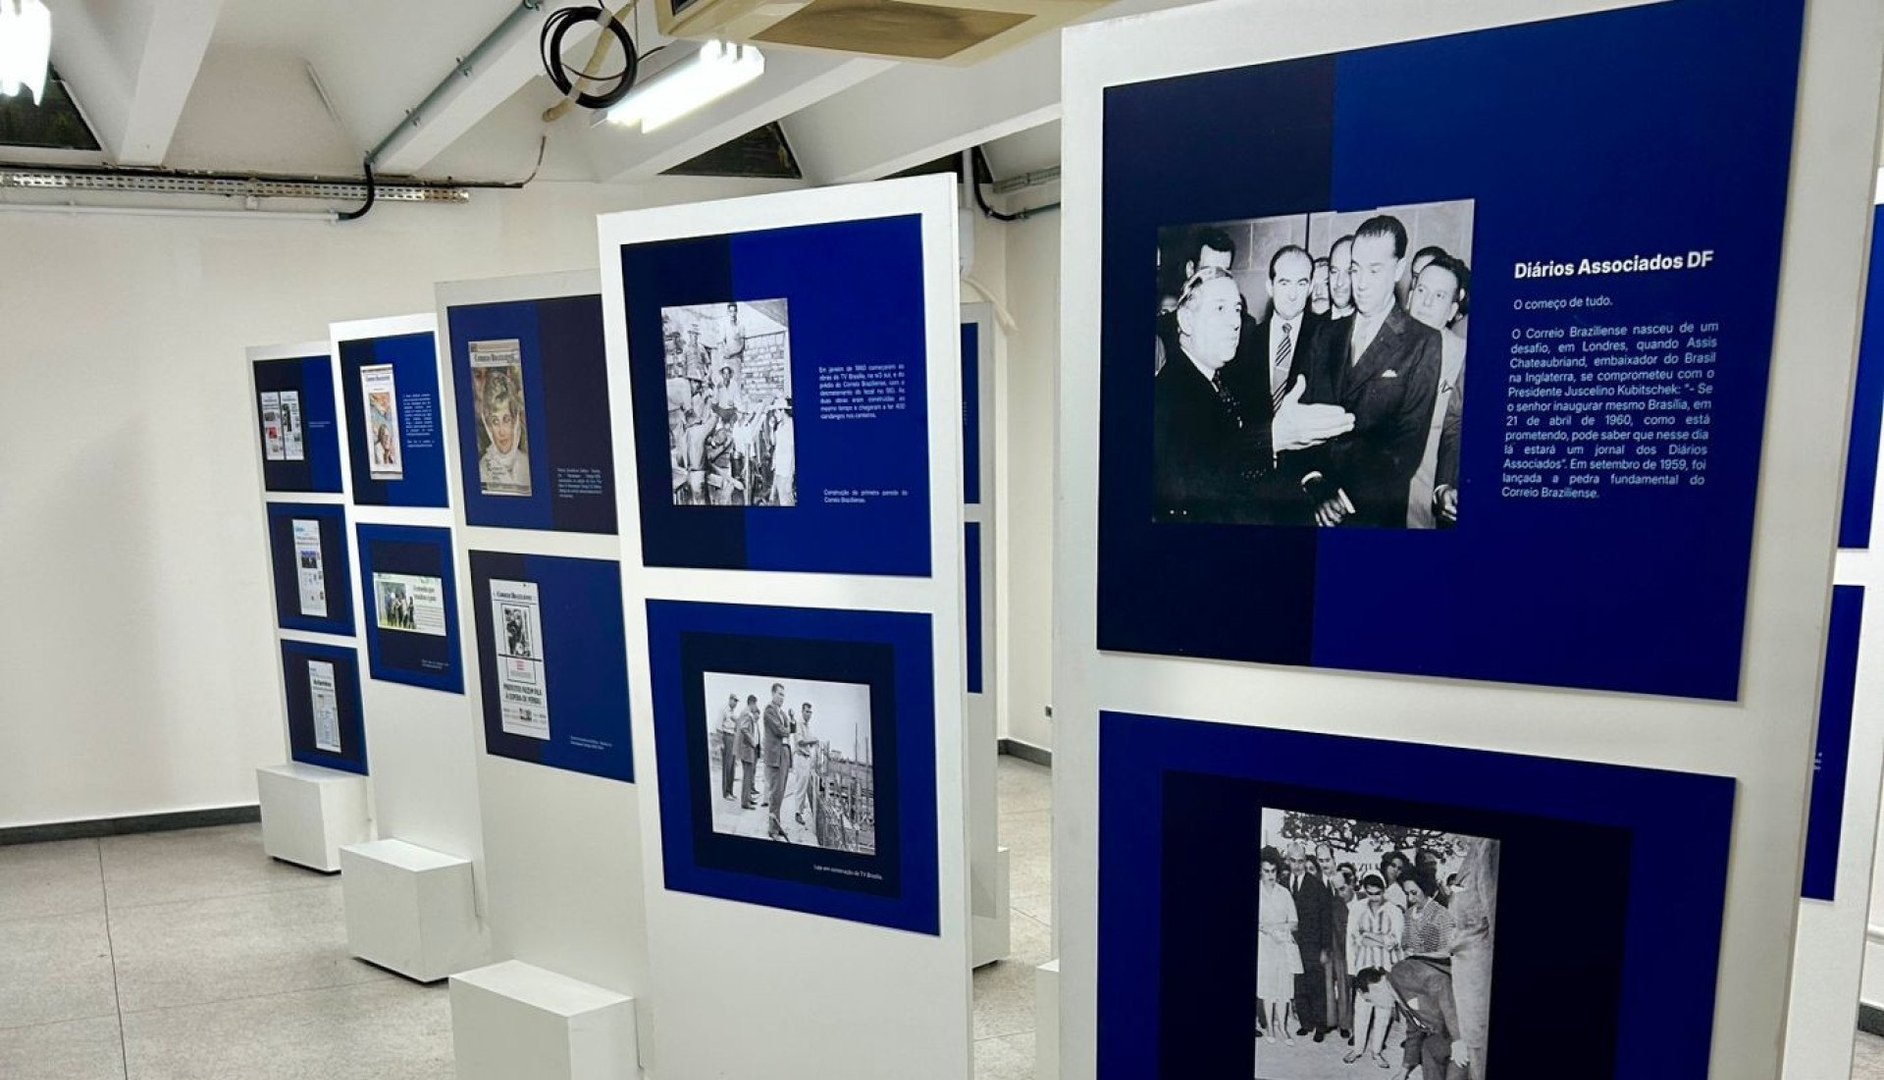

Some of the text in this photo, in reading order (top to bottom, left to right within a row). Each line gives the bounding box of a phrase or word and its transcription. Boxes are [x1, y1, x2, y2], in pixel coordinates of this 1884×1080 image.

[1514, 250, 1713, 278] Diários Associados DF
[1513, 296, 1612, 309] O começo de tudo.
[1511, 322, 1718, 339] O Correio Braziliense nasceu de um
[1510, 337, 1716, 353] desafio, em Londres, quando Assis
[1509, 352, 1715, 368] Chateaubriand, embaixador do Brasil
[1508, 369, 1714, 384] na Inglaterra, se comprometeu com o
[1508, 386, 1562, 397] Presidente
[1564, 385, 1614, 396] Juscelino
[1617, 383, 1680, 395] Kubitschek:
[1698, 383, 1712, 393] Se
[1507, 399, 1711, 412] o senhor inaugurar mesmo Brasília, em
[1506, 414, 1710, 426] 21 de abril de 1960, como está
[1505, 429, 1708, 441] prometendo, pode saber que nesse dia
[1504, 444, 1707, 456] lá estará um jornal dos Diários
[1570, 458, 1587, 469] Em
[1589, 459, 1640, 469] setembro
[1642, 459, 1656, 469] de
[1660, 458, 1688, 470] 1959,
[1692, 459, 1706, 469] foi
[1502, 472, 1541, 484] lançada
[1569, 474, 1599, 484] pedra
[1610, 473, 1678, 484] fundamental
[1689, 475, 1704, 484] do
[1502, 486, 1598, 498] Correio Braziliense.
